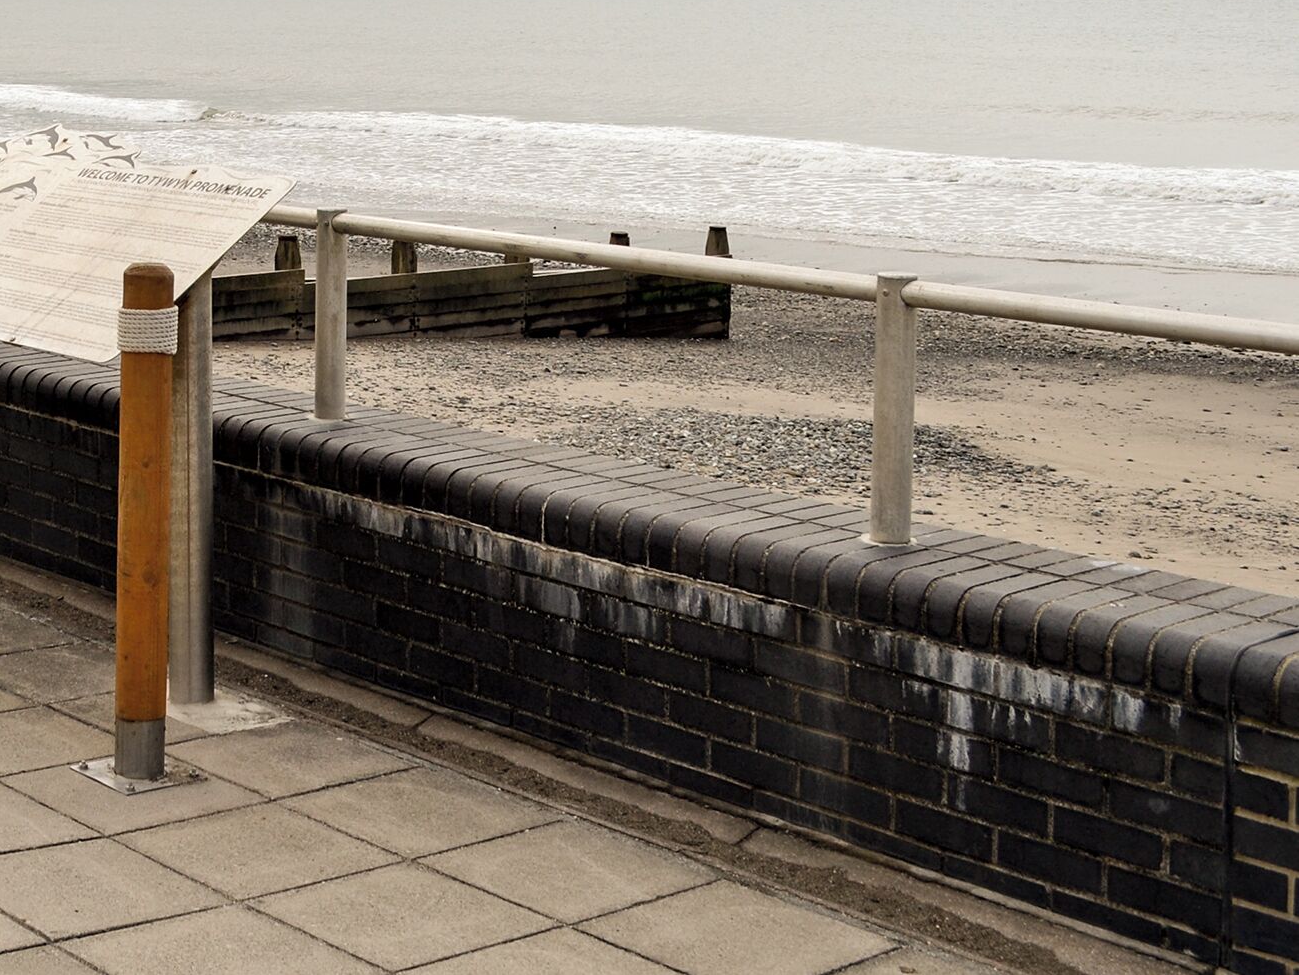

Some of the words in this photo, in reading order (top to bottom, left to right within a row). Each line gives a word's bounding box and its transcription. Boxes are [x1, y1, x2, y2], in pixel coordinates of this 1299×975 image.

[77, 168, 134, 184] WELCOME
[132, 174, 149, 185] TO
[149, 175, 193, 190] TYWYN
[191, 180, 272, 199] PROMENADE
